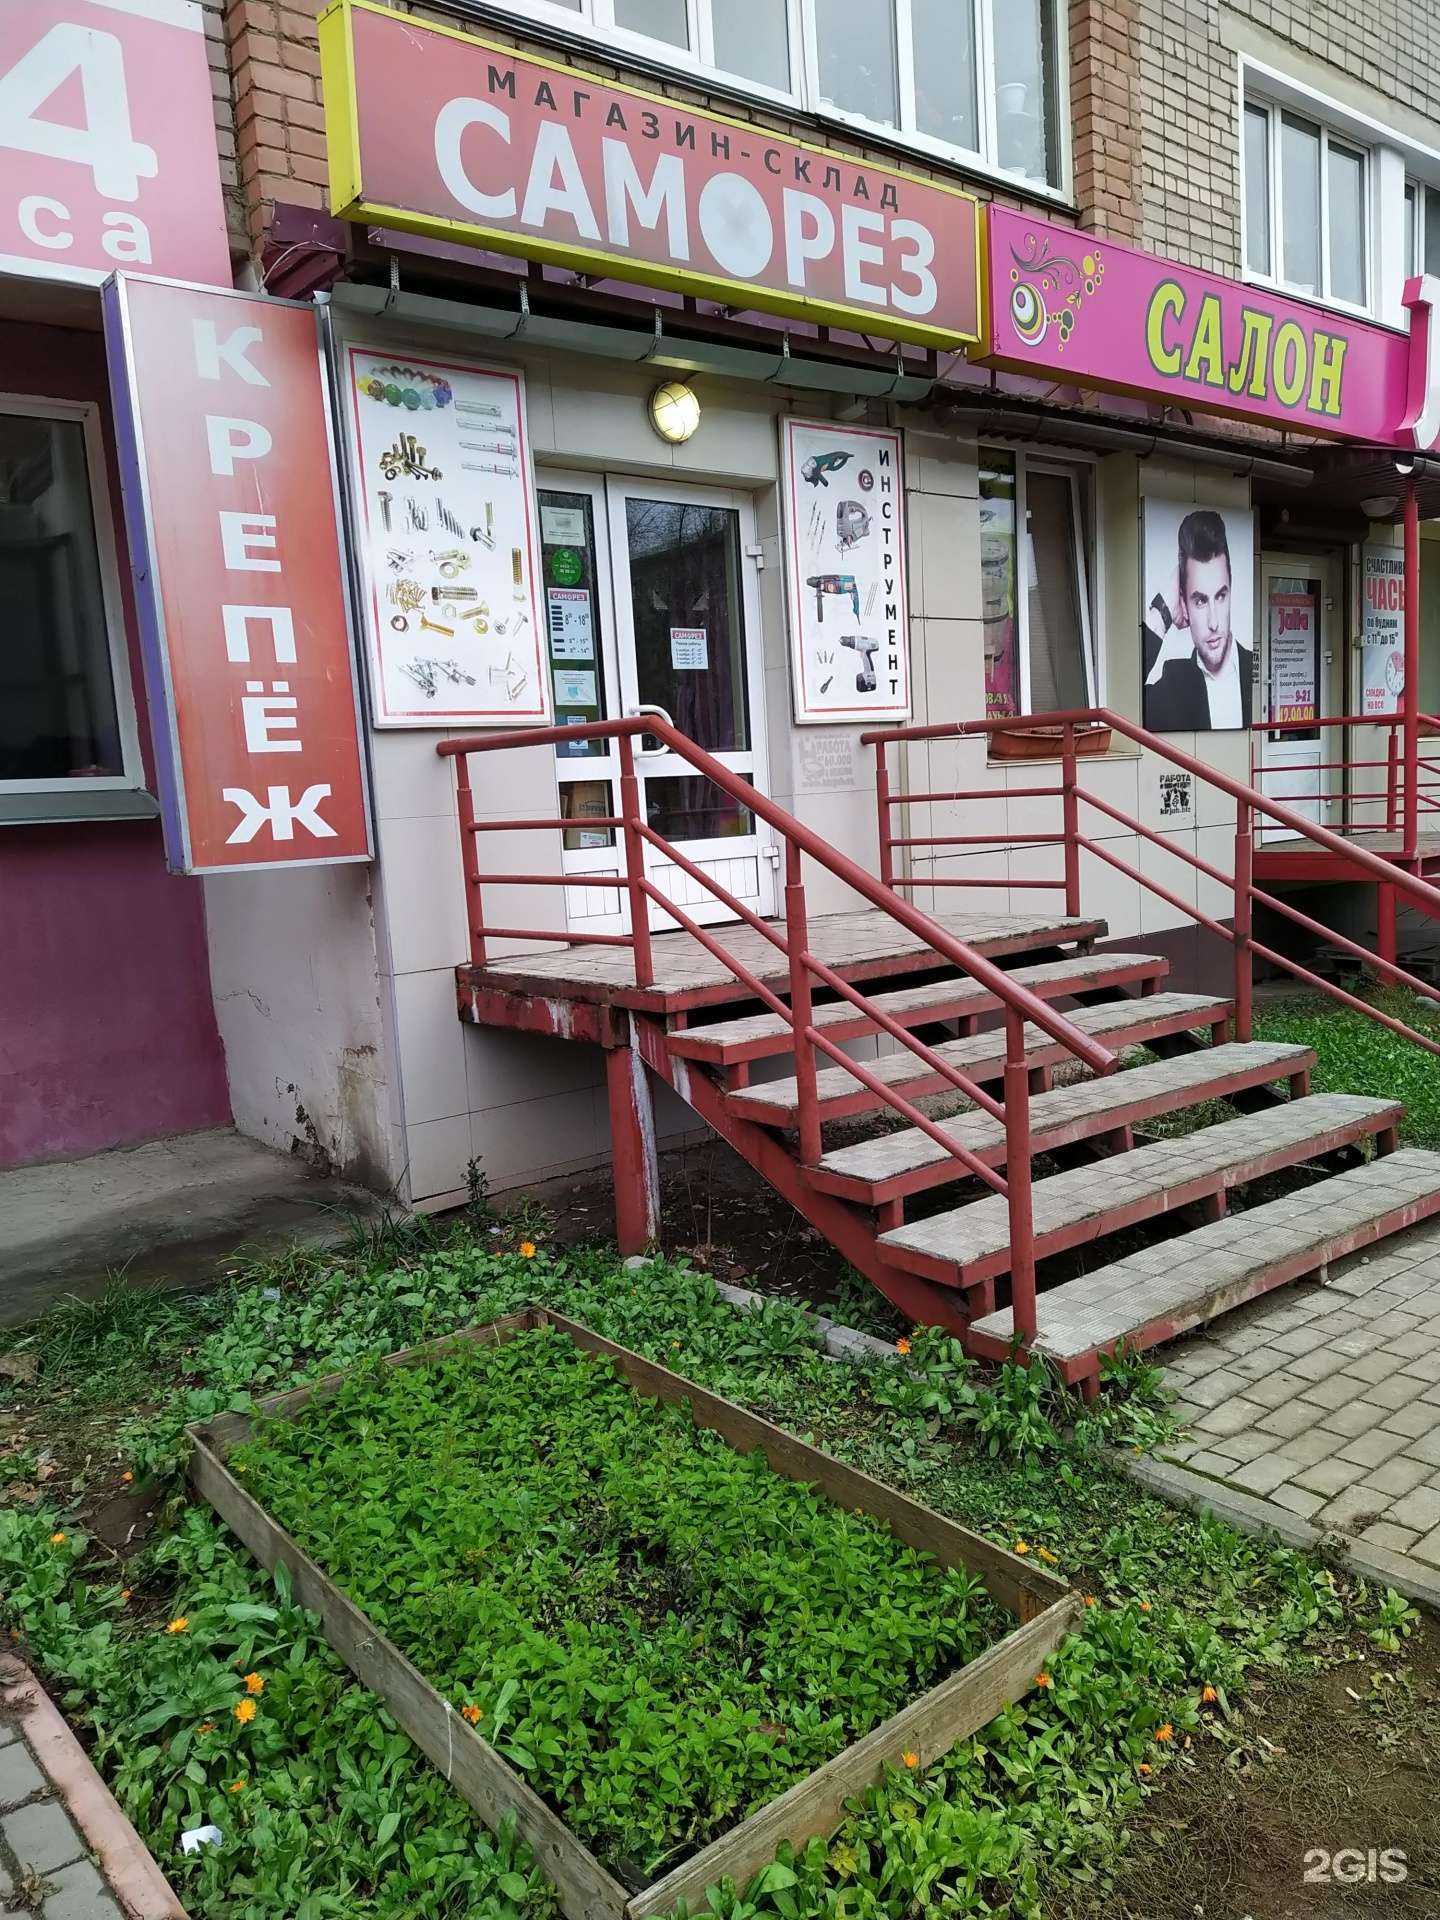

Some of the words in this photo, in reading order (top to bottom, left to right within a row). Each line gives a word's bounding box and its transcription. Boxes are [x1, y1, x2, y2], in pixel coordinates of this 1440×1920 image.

[434, 97, 938, 315] САМОРЕЗ
[488, 64, 900, 213] МАГАЗИН-СКЛАД
[1145, 278, 1348, 419] САЛОН
[192, 319, 338, 844] КРЕПЁЖ
[552, 592, 585, 601] САМОРЕЗ
[879, 450, 898, 695] ИНСТРУМЕНТ
[1367, 558, 1404, 575] СЧАСТЛИВ
